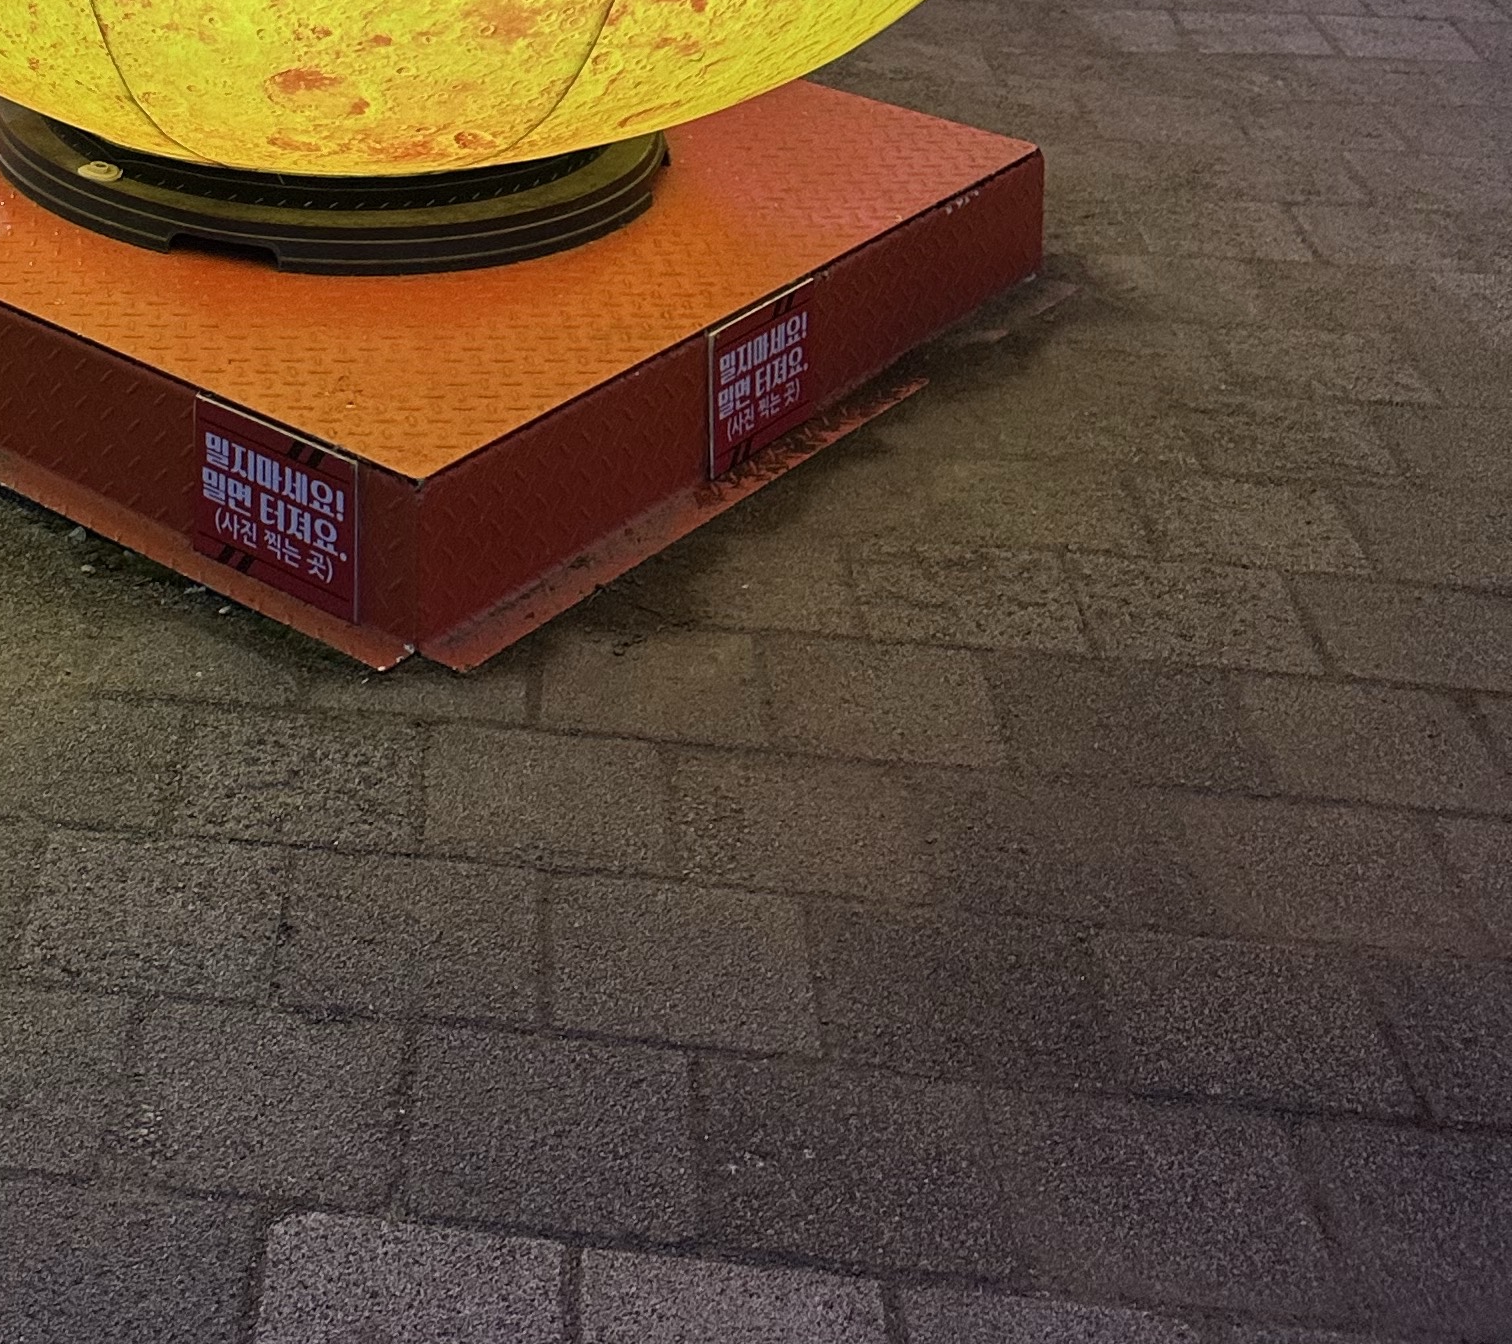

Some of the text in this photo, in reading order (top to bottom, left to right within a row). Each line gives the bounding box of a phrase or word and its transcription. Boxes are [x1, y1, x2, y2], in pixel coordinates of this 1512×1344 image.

[718, 346, 809, 421] 밀면 터져요.
[719, 312, 808, 385] 밀지마세요!
[726, 377, 801, 442] (사진 찍는 곳)
[202, 466, 347, 562] 밀면 터져요.
[204, 431, 345, 522] 밀지마세요!
[215, 507, 334, 584] (사진 찍는 곳)
